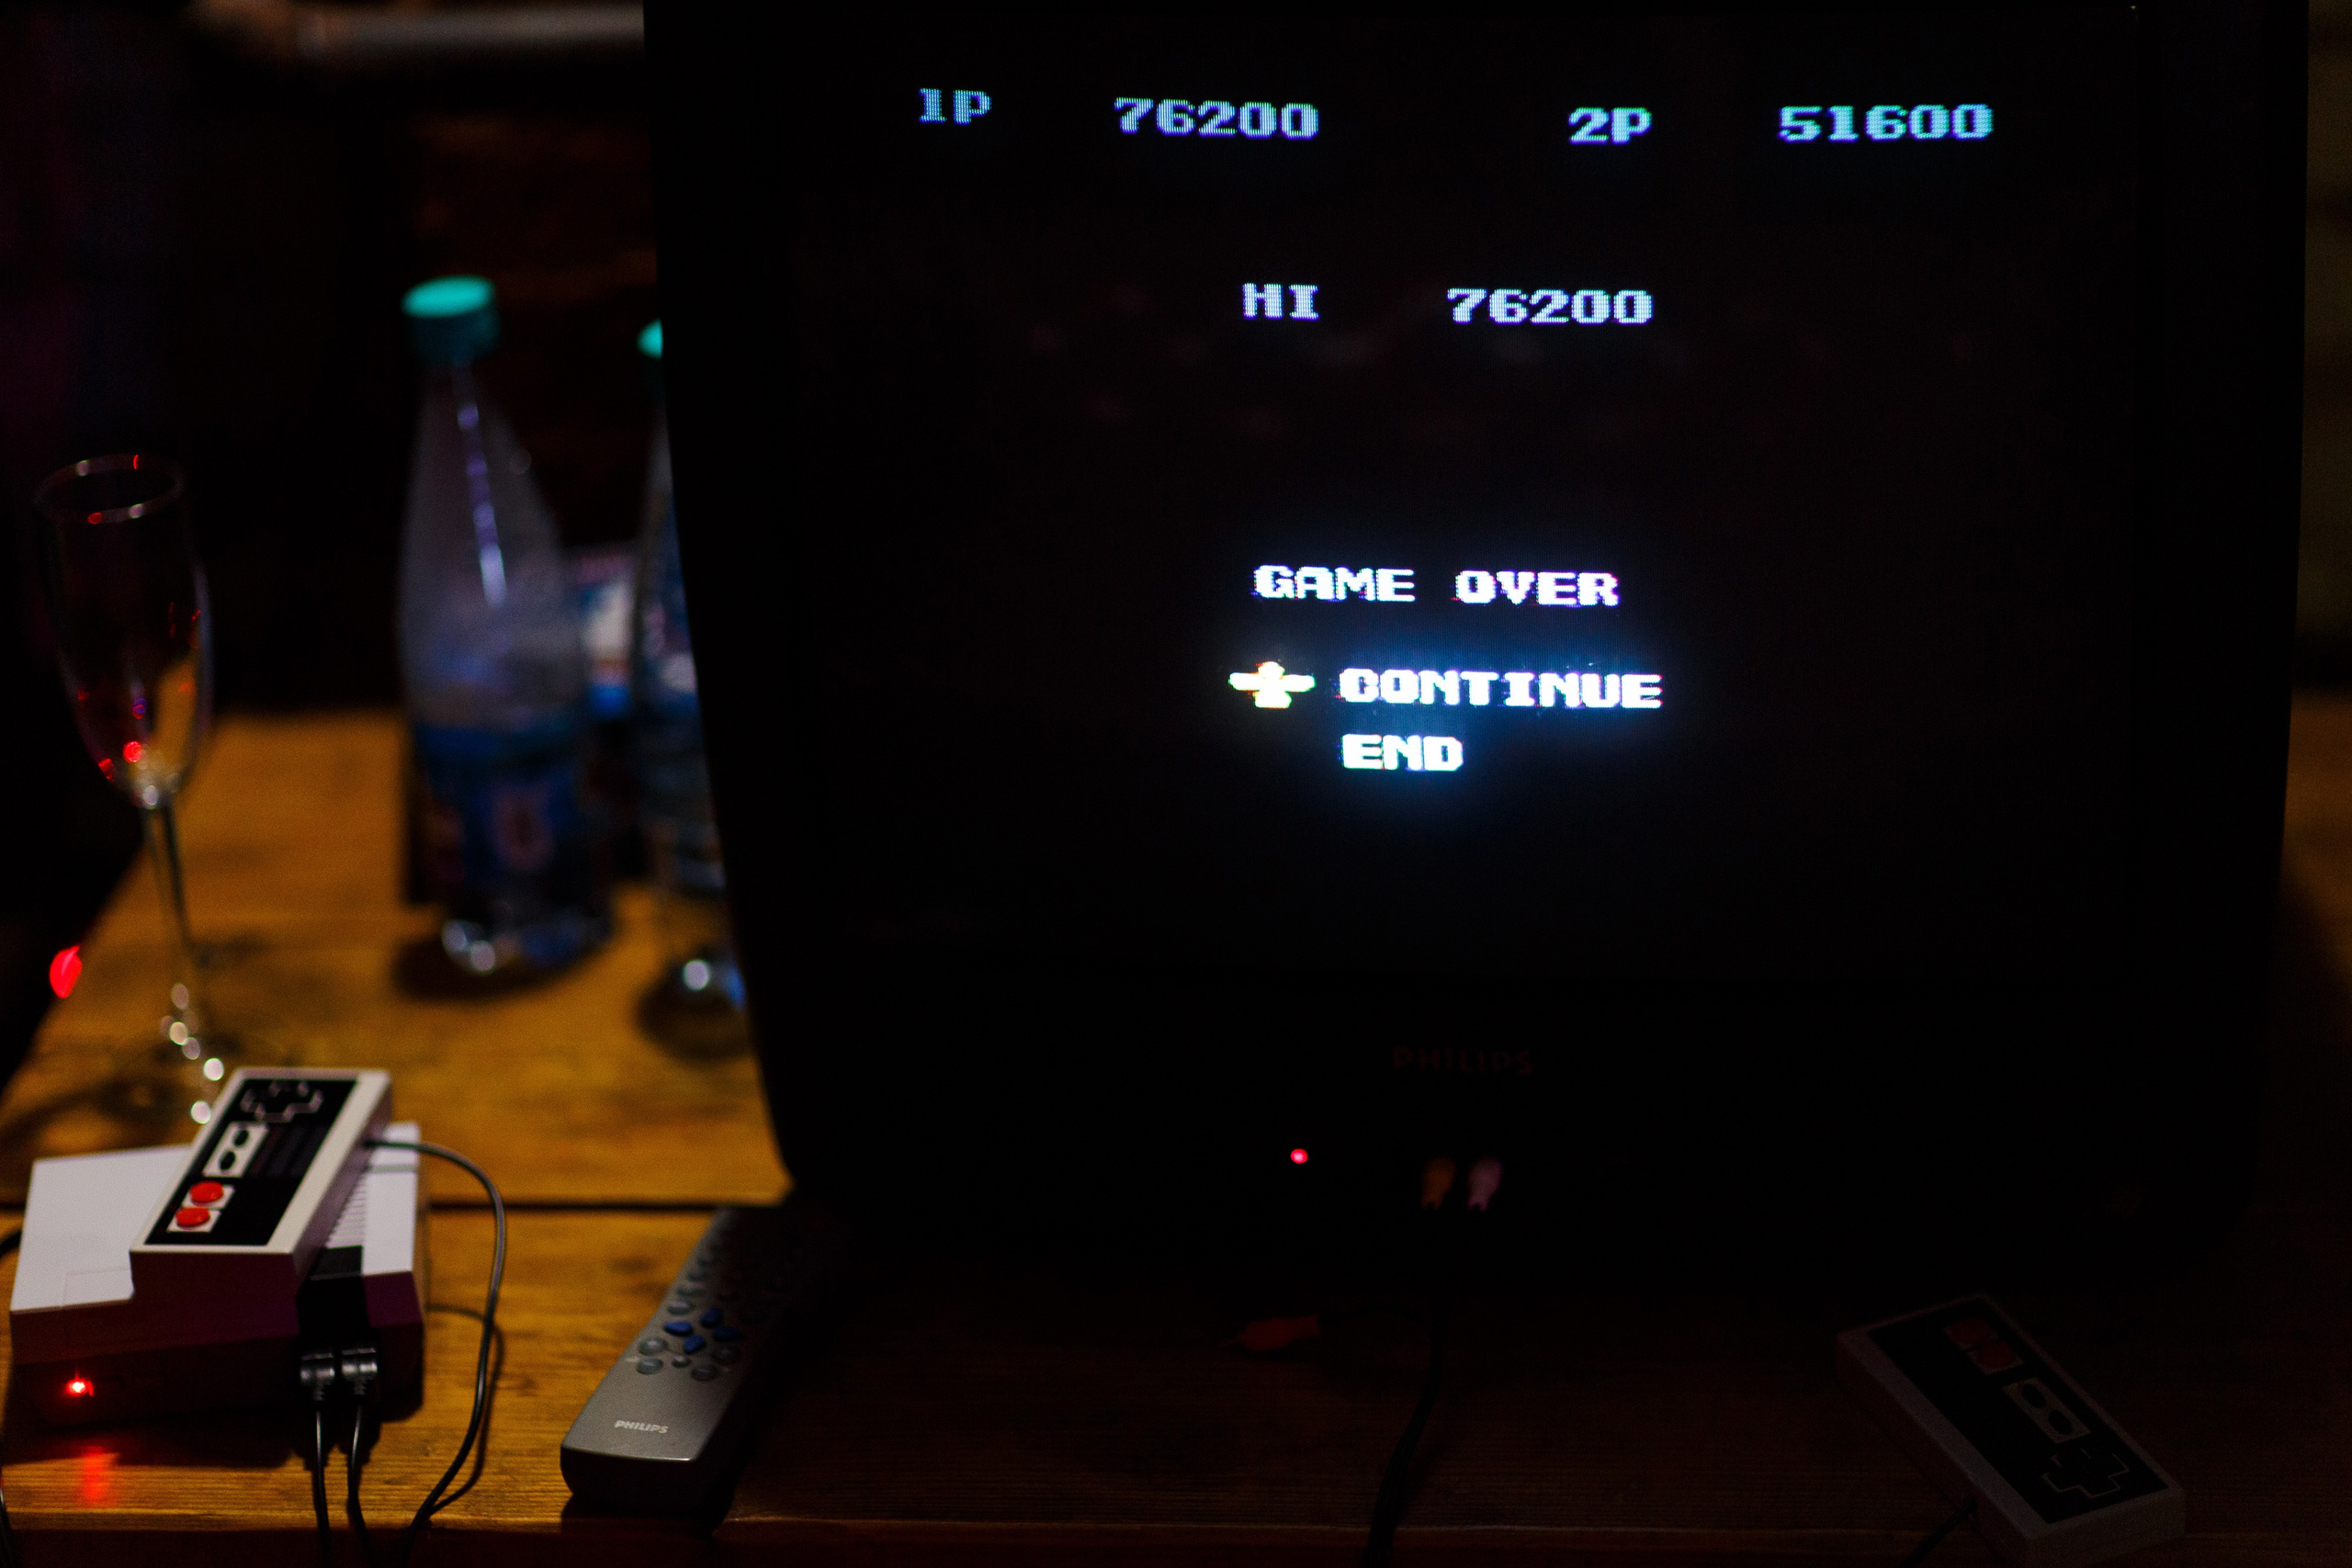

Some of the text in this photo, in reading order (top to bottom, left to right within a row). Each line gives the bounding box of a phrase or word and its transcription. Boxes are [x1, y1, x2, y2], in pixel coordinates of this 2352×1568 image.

[918, 87, 1994, 146] 1P 76200 2P 51600
[1241, 282, 1654, 326] HI 76200
[1250, 563, 1623, 610] GAME OVER
[1336, 667, 1665, 711] CONTINUE
[1338, 732, 1465, 773] END
[1391, 1044, 1535, 1077] PHILIPS
[614, 1419, 669, 1434] PHILIPS
